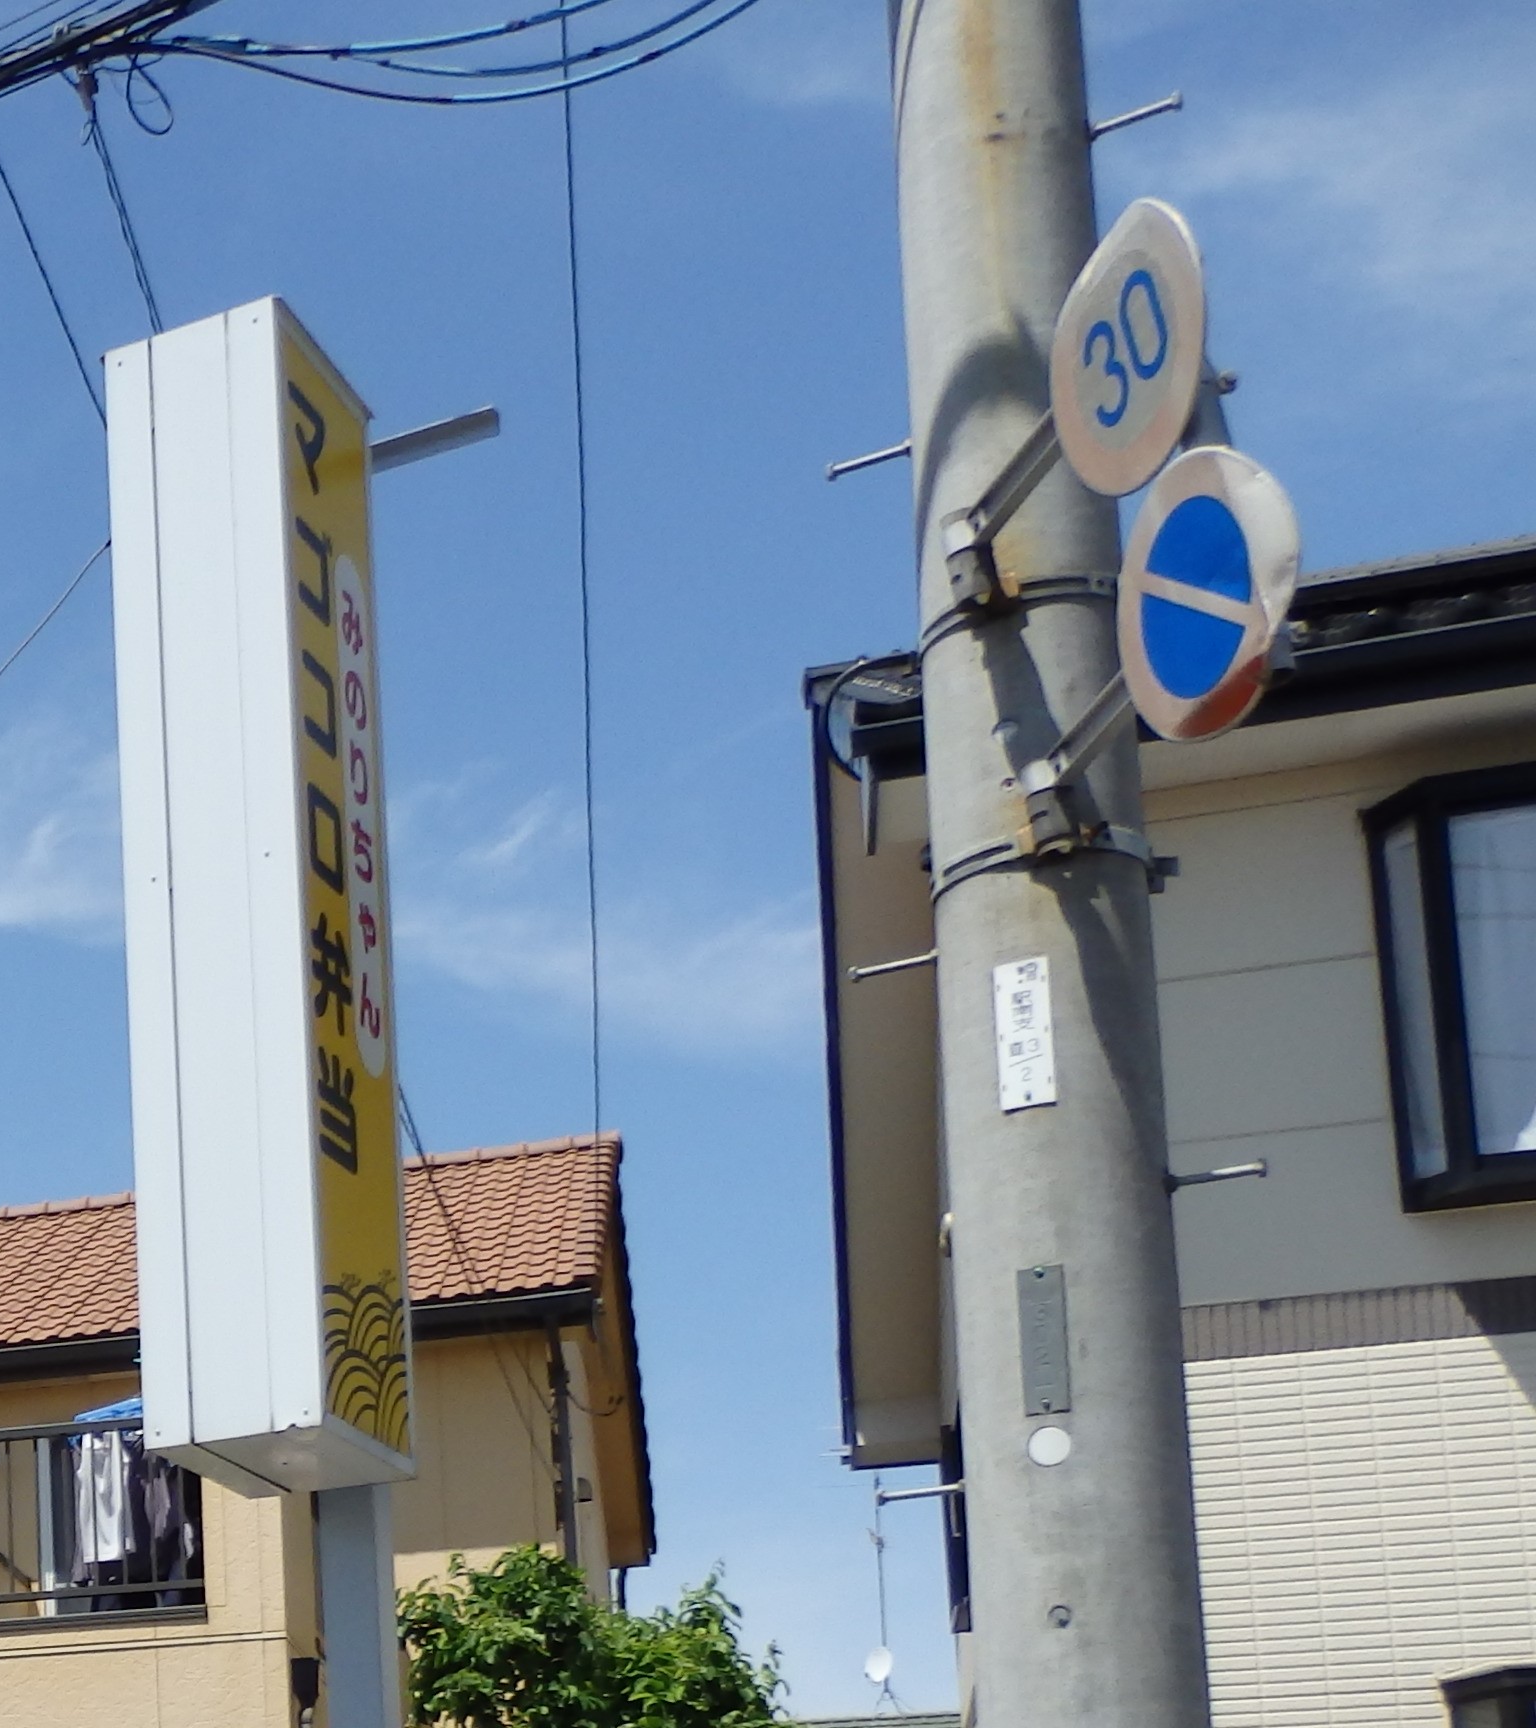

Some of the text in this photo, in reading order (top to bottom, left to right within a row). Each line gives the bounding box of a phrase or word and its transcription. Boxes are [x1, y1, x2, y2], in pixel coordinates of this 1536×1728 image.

[1083, 268, 1168, 429] 30
[287, 378, 359, 1176] マゴコロ弁当
[341, 588, 382, 1039] みのりちゃん
